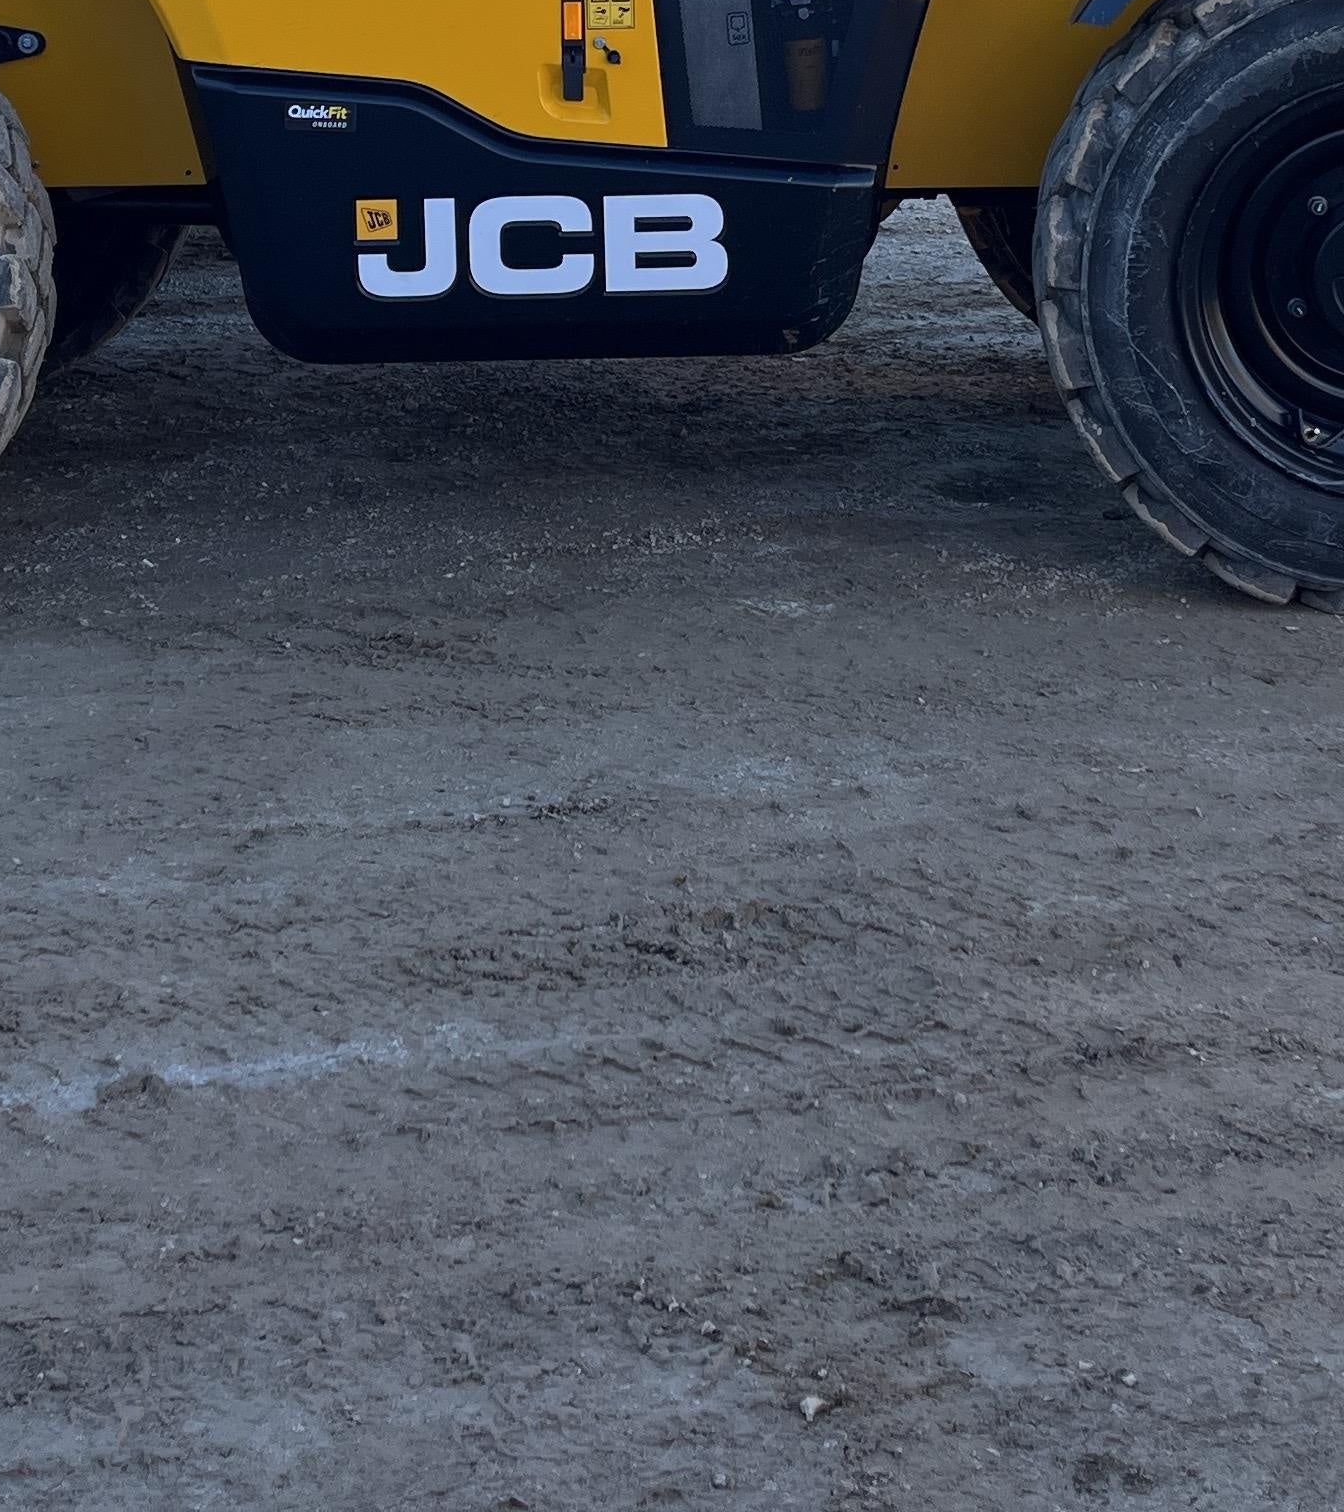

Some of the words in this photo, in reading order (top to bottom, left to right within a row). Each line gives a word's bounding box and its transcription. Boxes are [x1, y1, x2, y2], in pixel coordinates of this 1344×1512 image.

[287, 104, 348, 120] QuickFit
[367, 212, 391, 230] JCB
[356, 193, 729, 298] JCB
